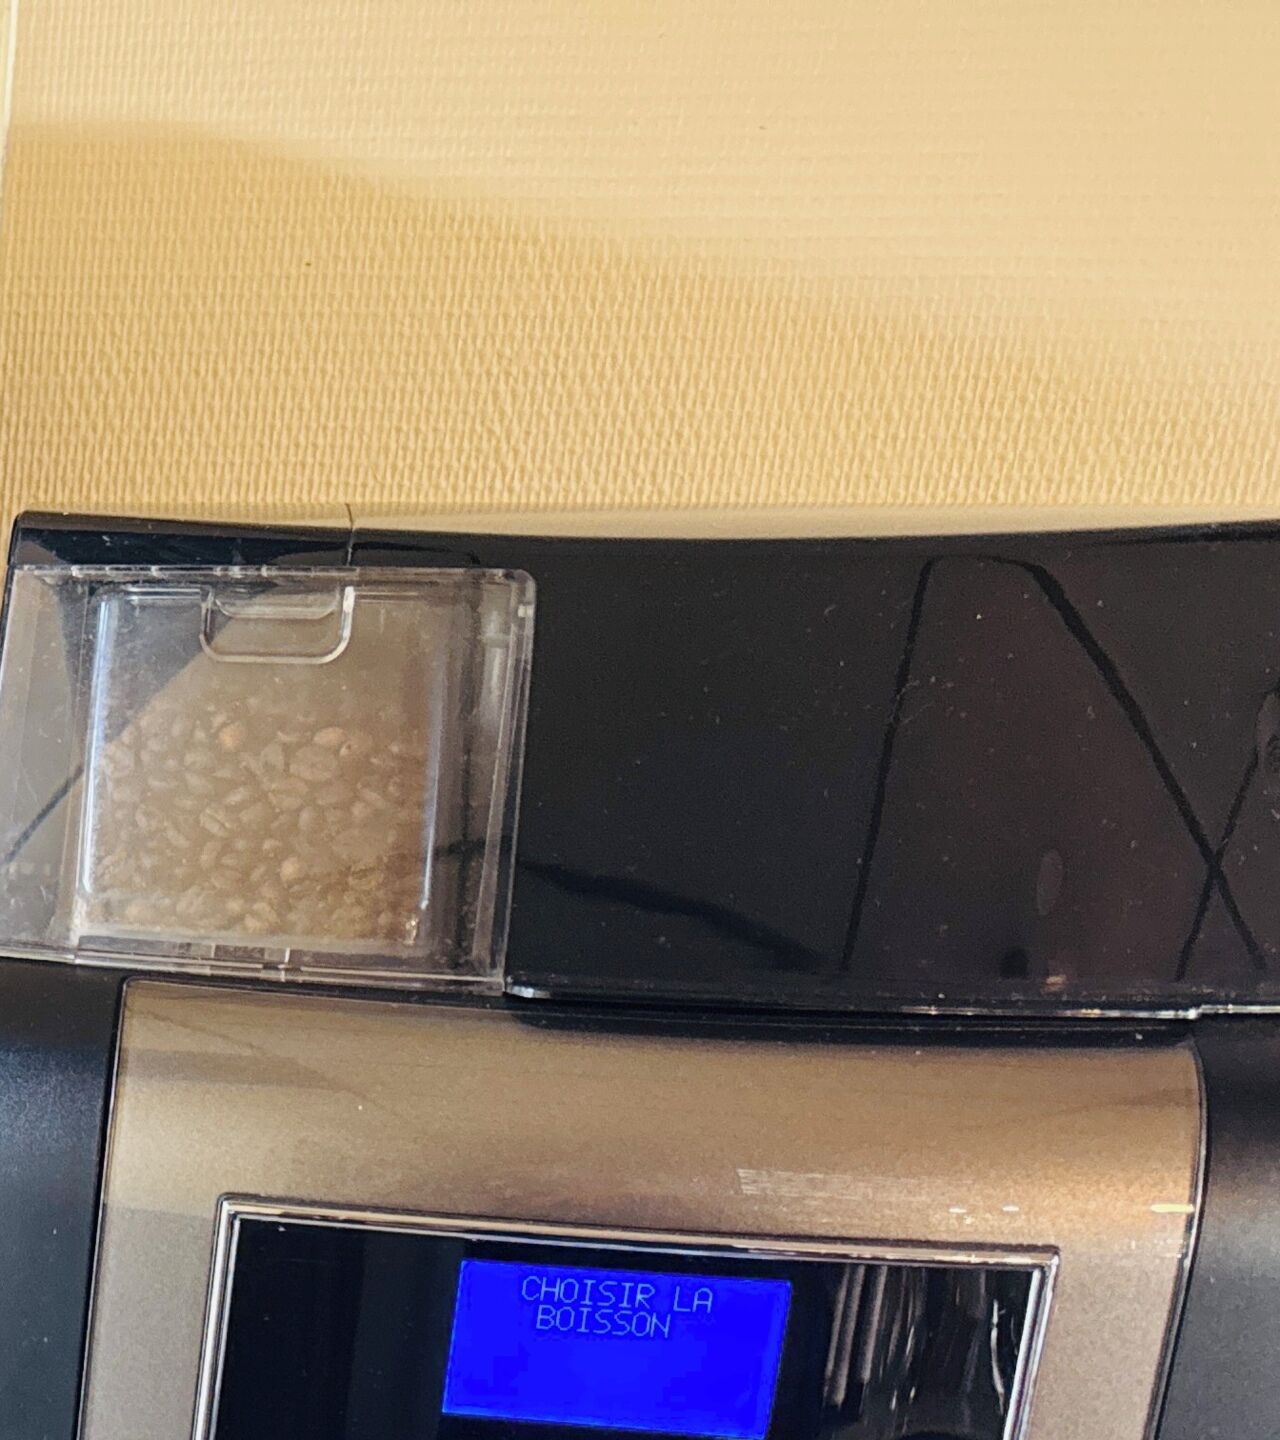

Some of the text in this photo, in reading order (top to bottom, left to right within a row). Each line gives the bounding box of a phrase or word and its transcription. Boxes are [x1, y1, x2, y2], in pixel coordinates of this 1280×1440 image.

[521, 1275, 713, 1313] CHOISIR LA
[536, 1304, 671, 1338] BOISSON
